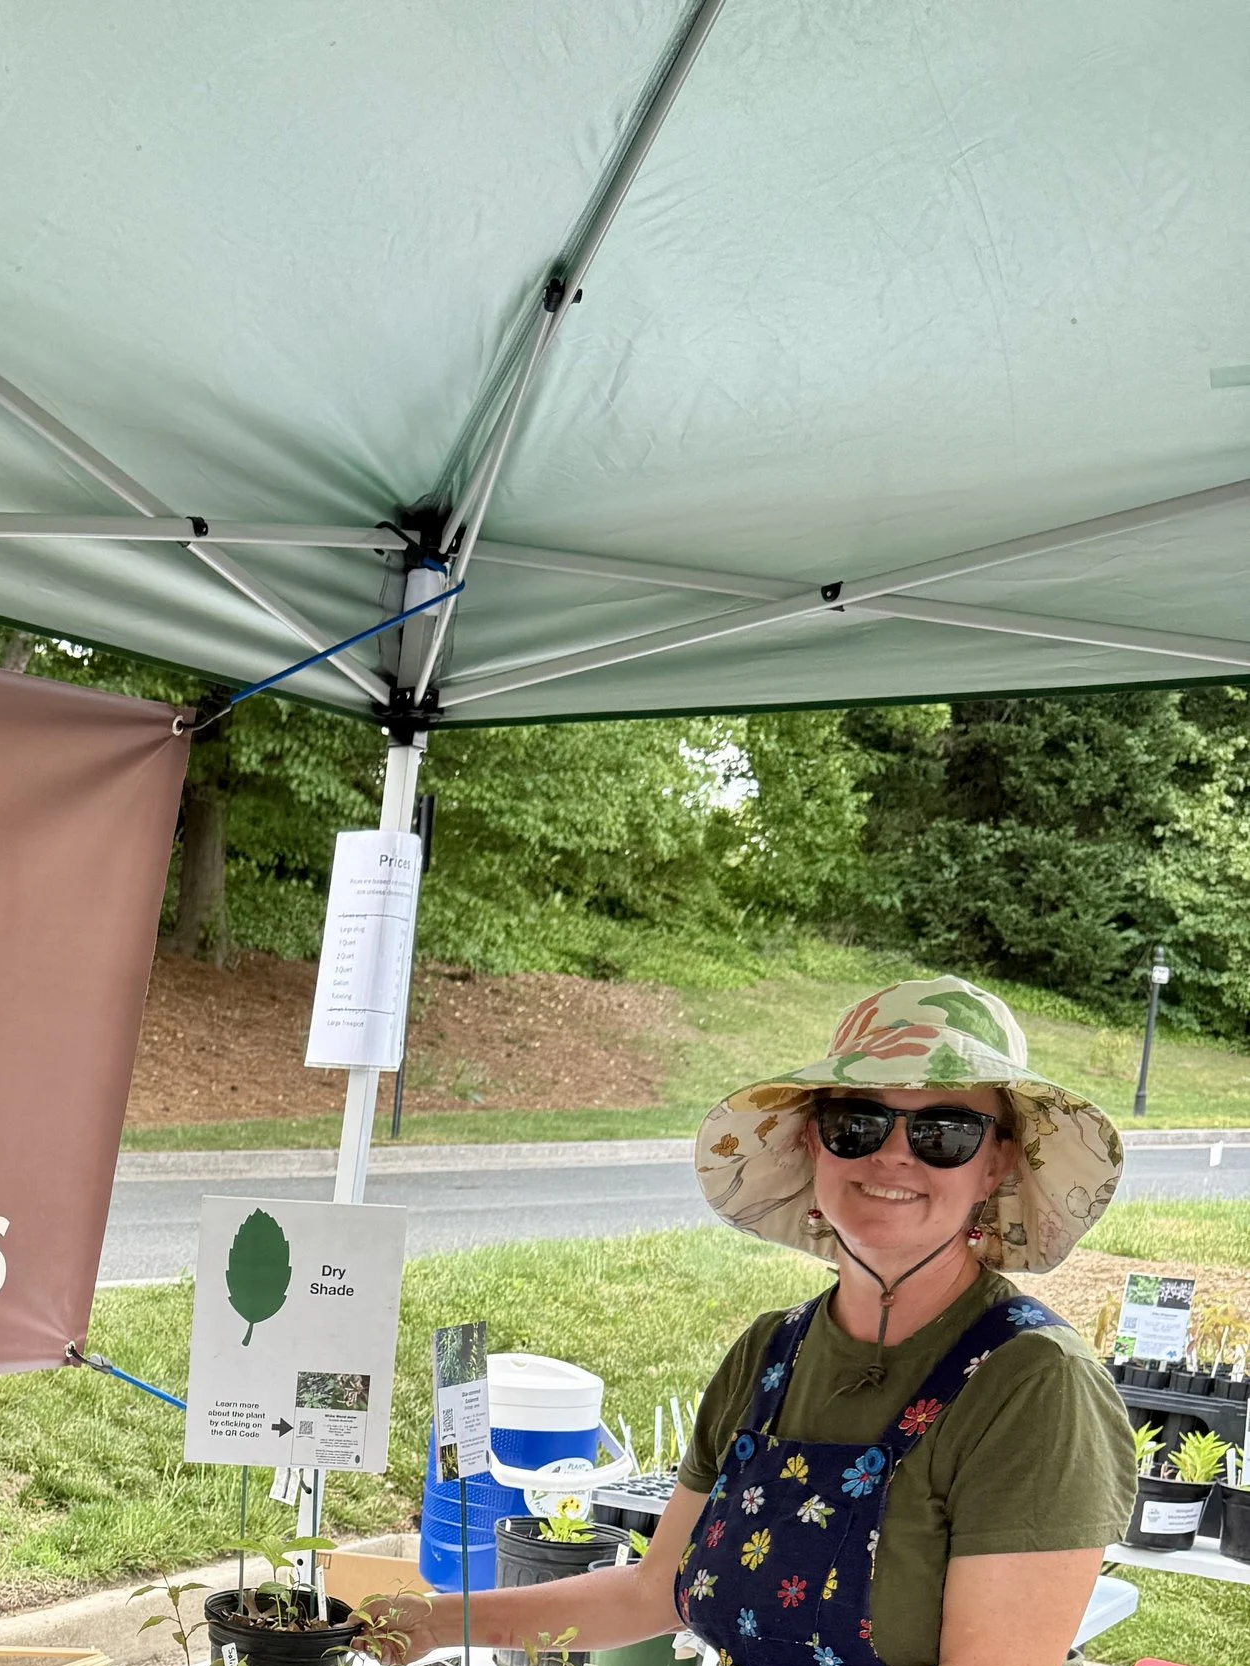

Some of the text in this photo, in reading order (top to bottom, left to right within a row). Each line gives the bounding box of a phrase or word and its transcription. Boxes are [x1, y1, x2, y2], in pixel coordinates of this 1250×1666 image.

[321, 1264, 347, 1280] Dry
[310, 1282, 354, 1297] Shade
[215, 1400, 238, 1408] Learn
[209, 1419, 219, 1427] by
[221, 1420, 251, 1429] clicking
[225, 1429, 237, 1437] QR
[239, 1430, 260, 1438] Code
